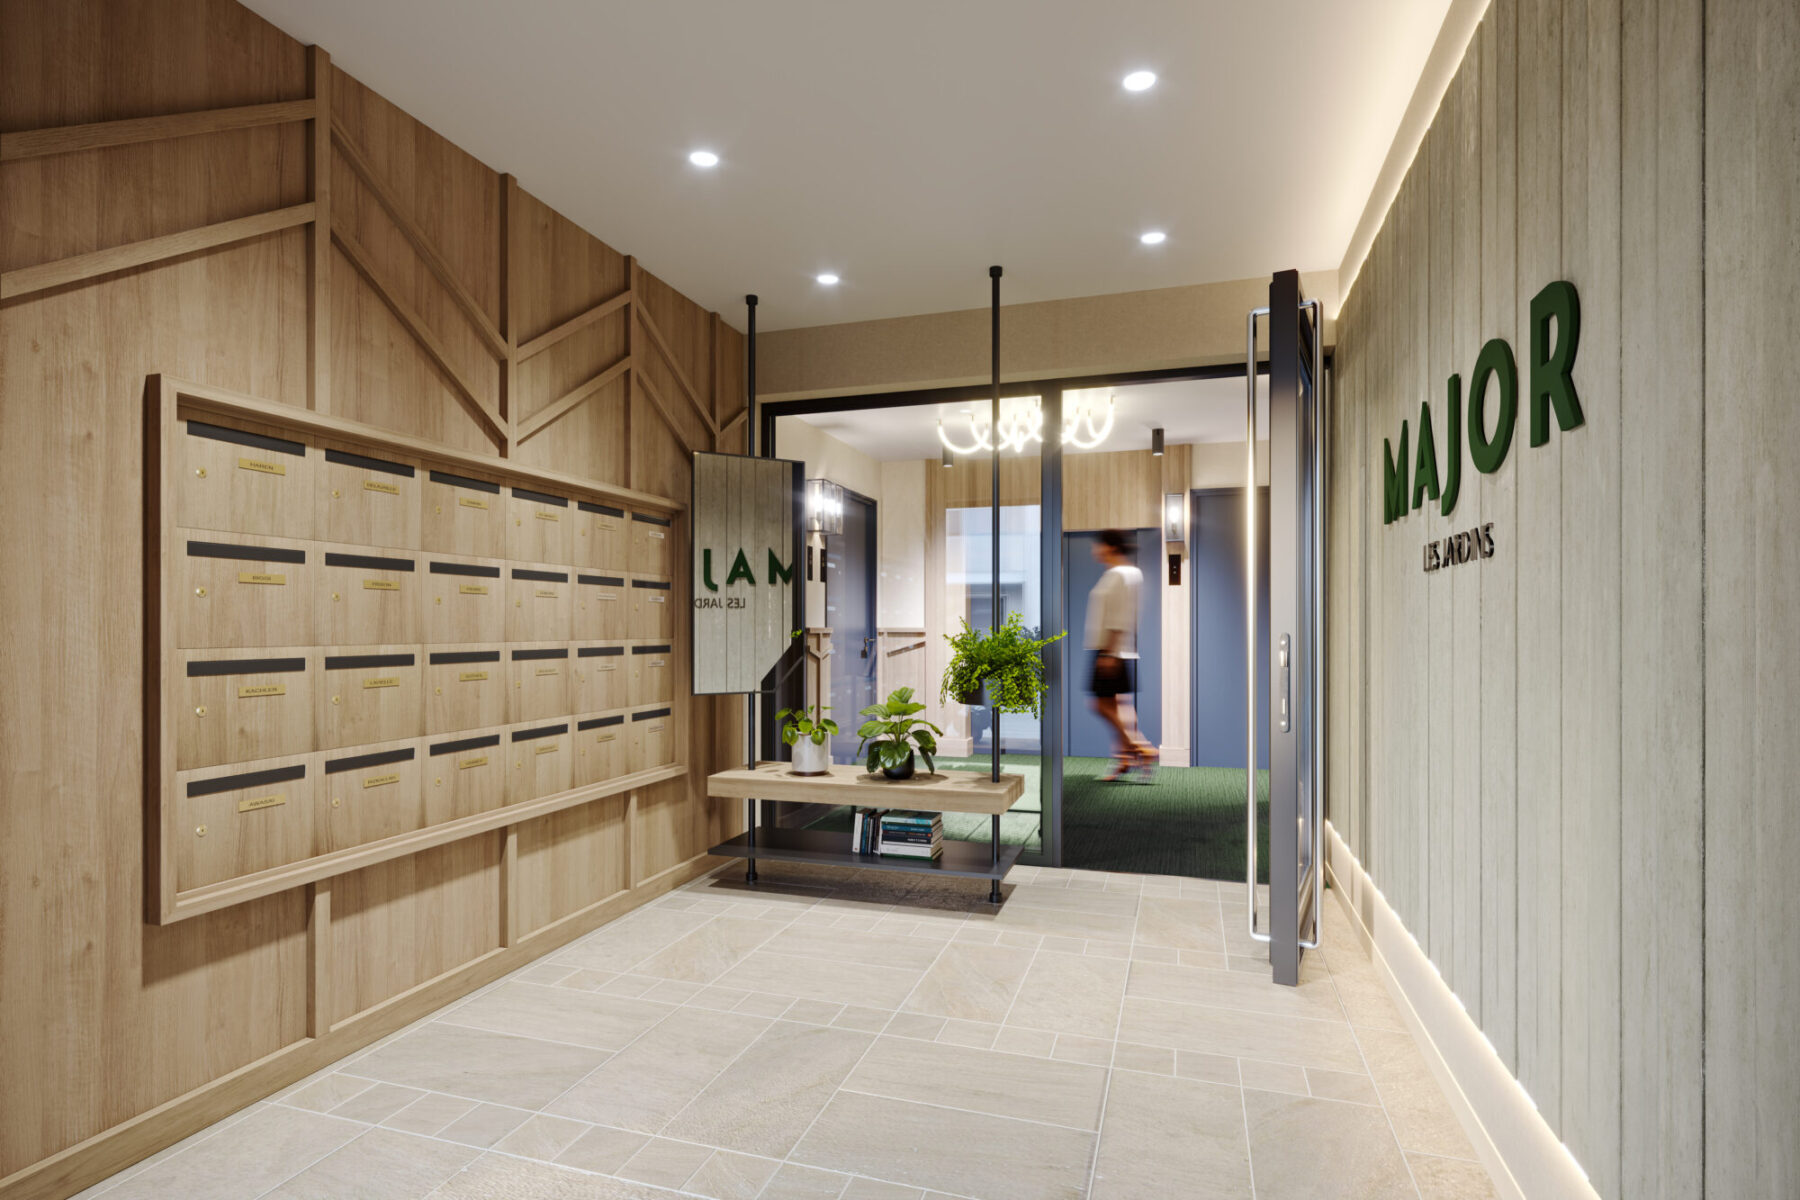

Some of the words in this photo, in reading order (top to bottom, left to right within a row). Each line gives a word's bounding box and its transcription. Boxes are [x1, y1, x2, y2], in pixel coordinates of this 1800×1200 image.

[1384, 281, 1585, 525] MAJOR
[1423, 541, 1440, 572] LES
[1441, 522, 1494, 568] JARDINS
